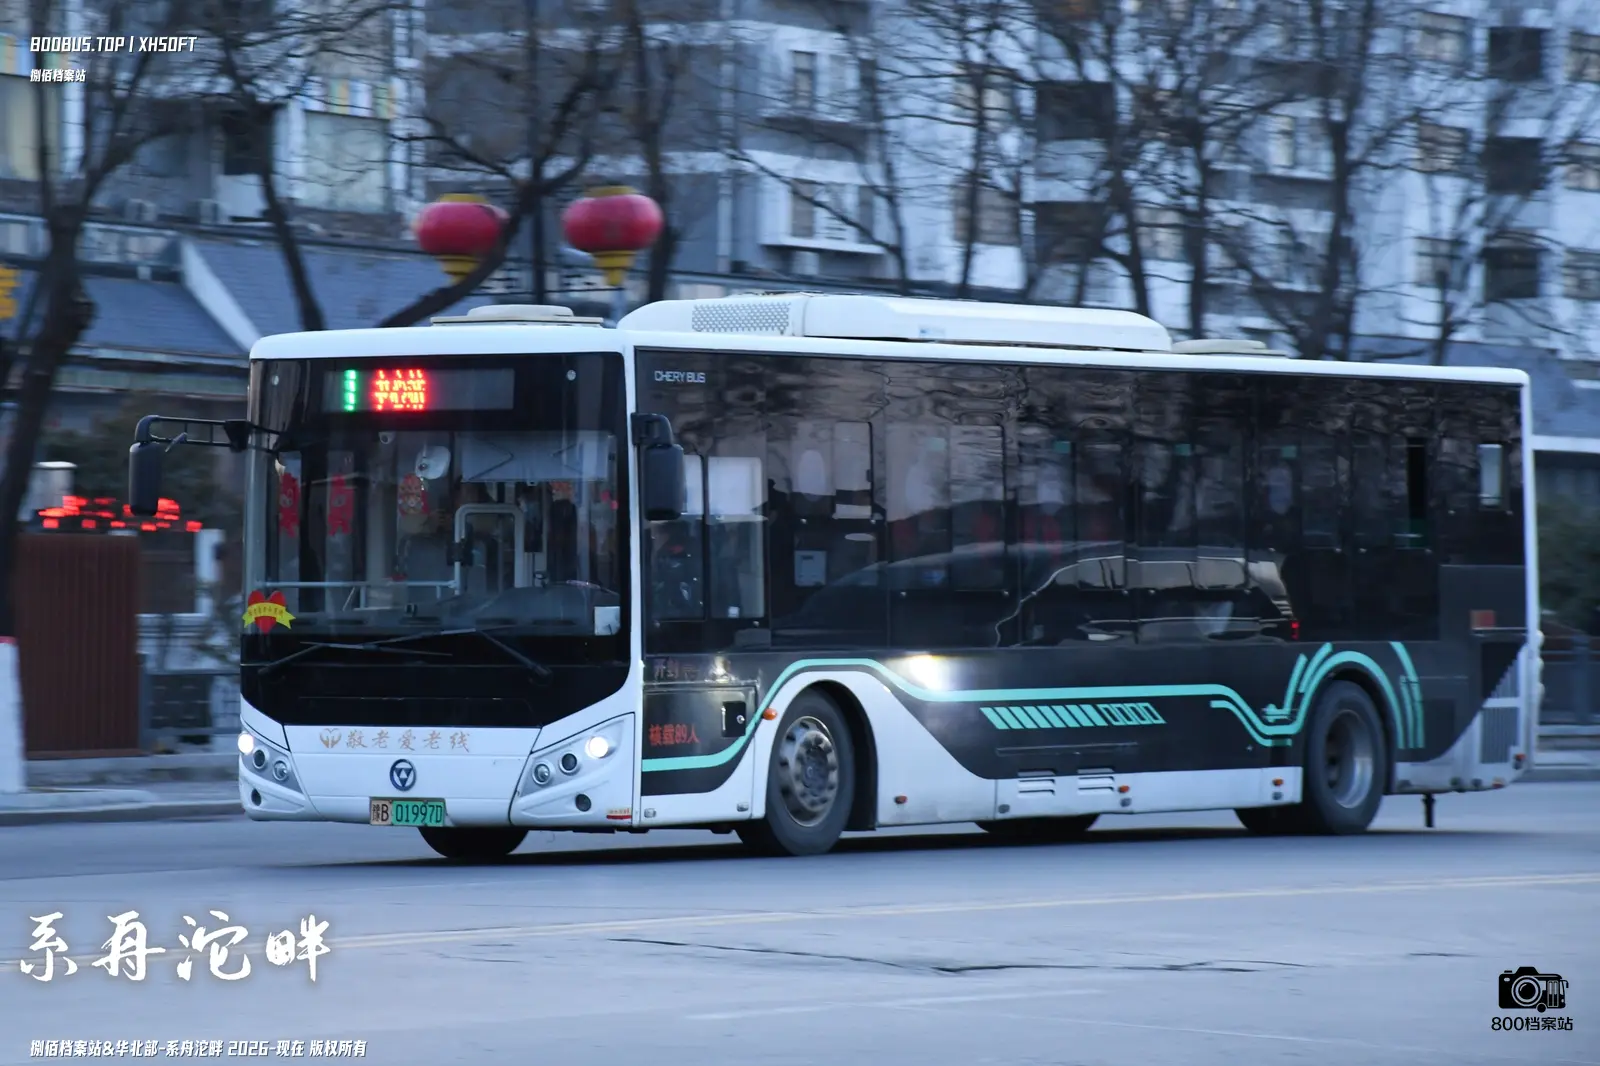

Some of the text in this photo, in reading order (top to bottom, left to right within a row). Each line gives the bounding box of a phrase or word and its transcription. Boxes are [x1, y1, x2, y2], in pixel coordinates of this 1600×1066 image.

[654, 370, 706, 384] CHERY BUS
[346, 728, 470, 753] 敬老爱老线
